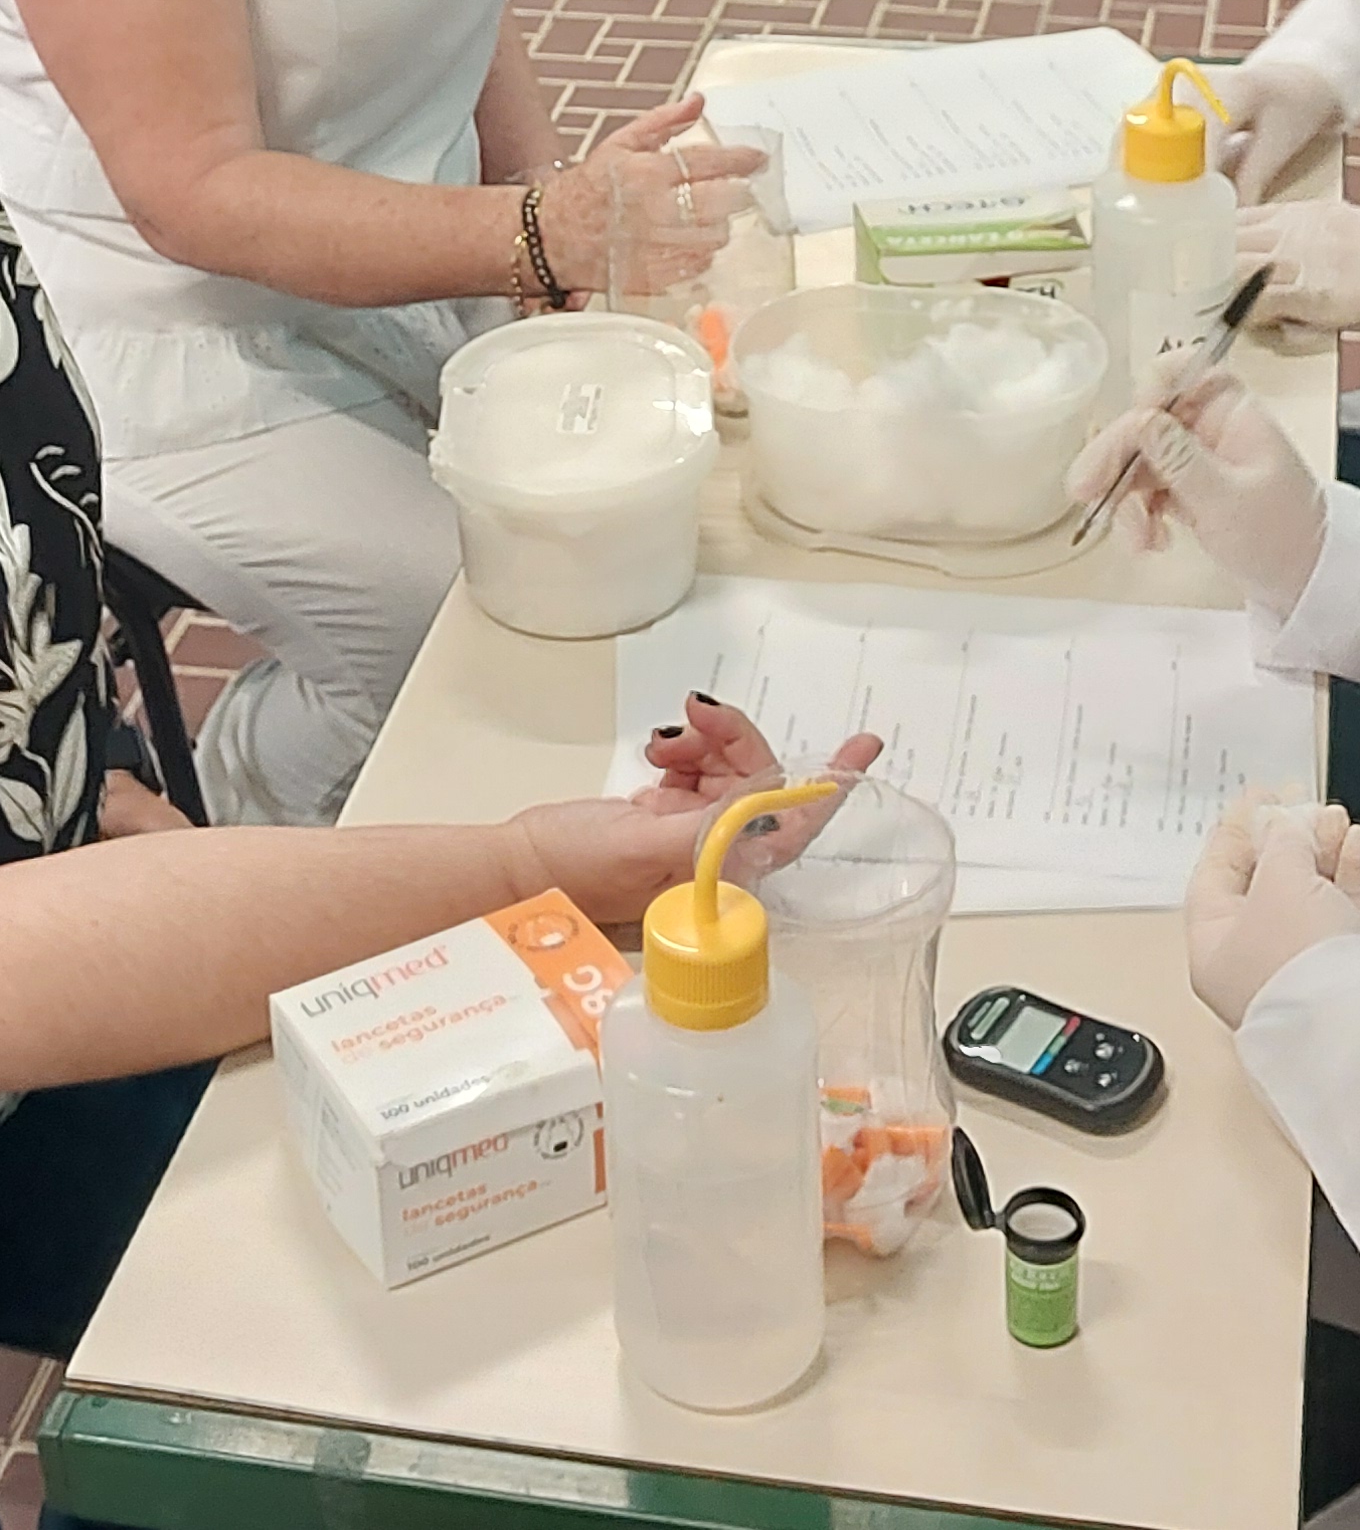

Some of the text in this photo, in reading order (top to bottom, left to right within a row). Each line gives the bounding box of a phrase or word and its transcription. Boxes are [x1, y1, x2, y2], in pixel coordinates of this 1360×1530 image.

[299, 945, 450, 1019] uniqmed
[330, 1003, 438, 1053] lancetas
[377, 992, 508, 1051] segurança
[401, 1183, 488, 1222] lancetas
[433, 1179, 539, 1226] segurança
